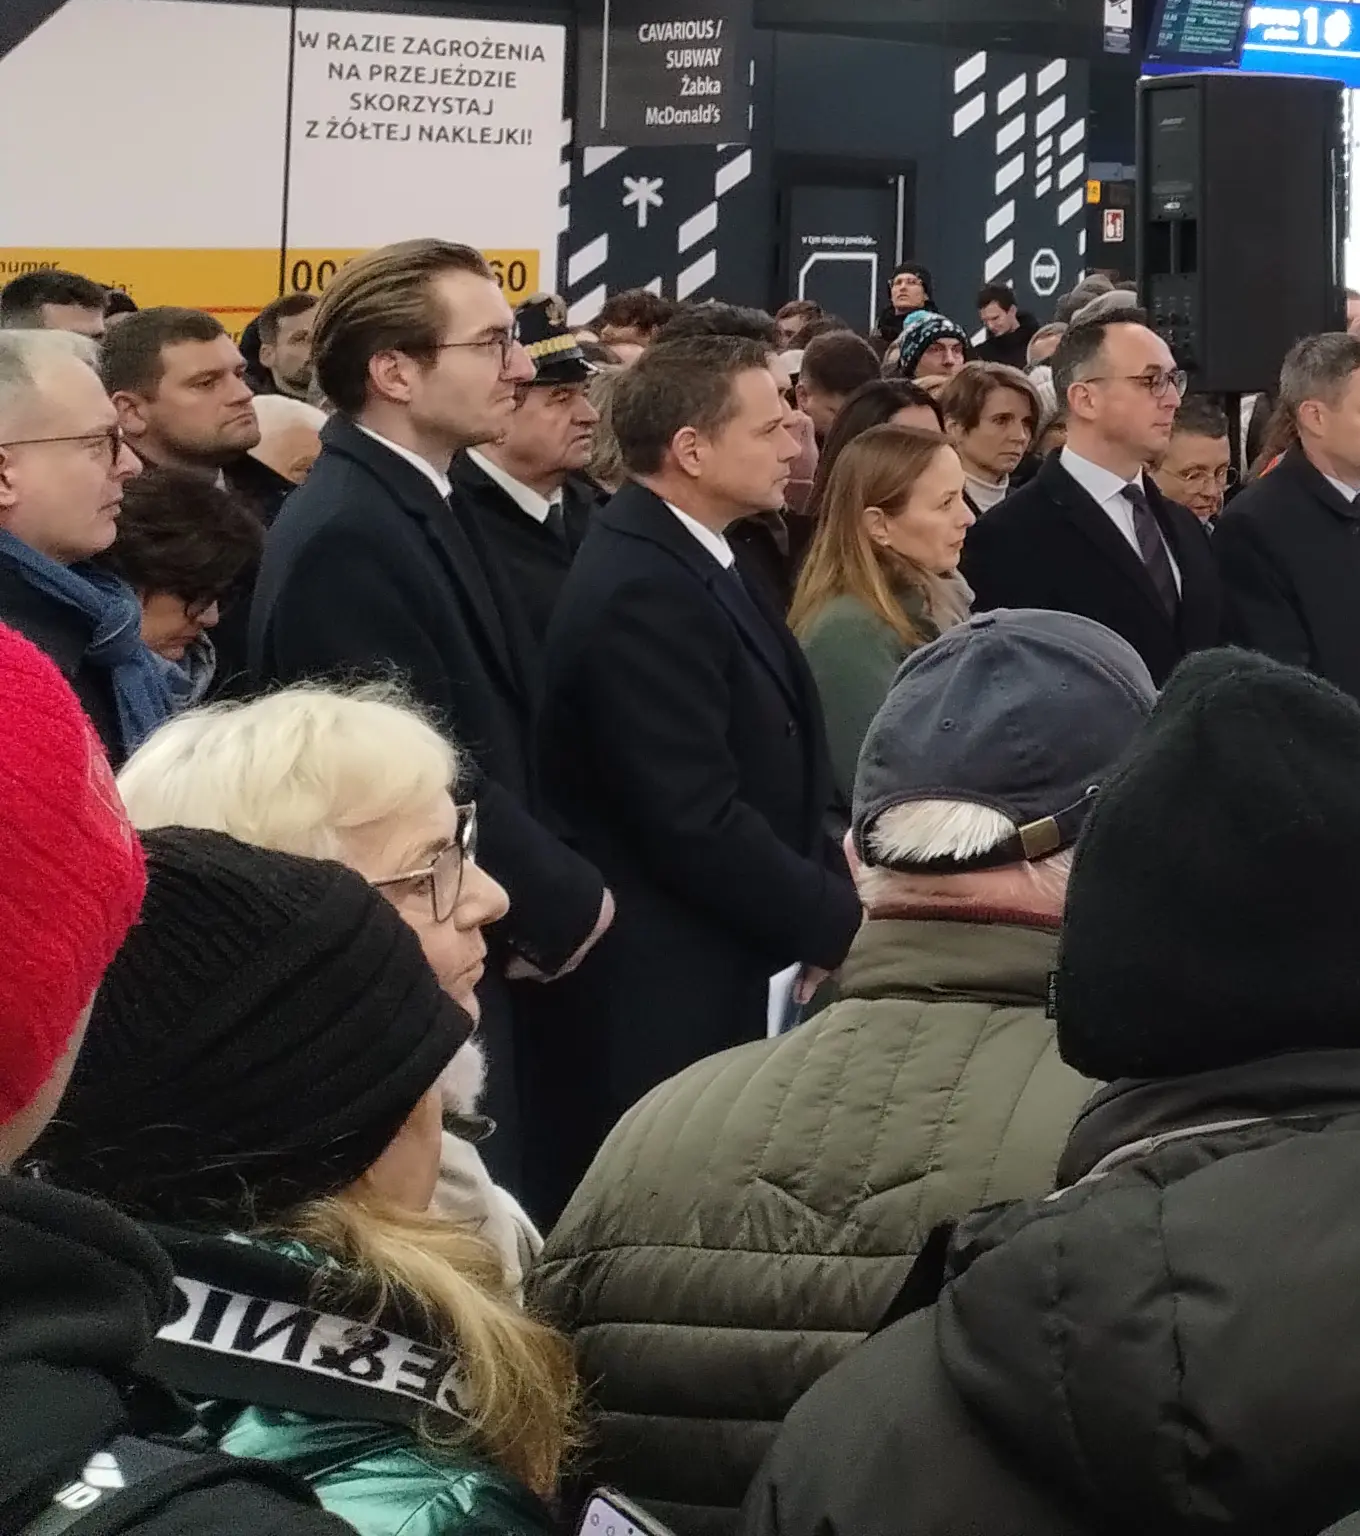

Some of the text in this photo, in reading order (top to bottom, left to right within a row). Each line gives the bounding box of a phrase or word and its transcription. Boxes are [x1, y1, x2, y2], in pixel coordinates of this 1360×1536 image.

[638, 19, 723, 42] CAVARIOUS /
[297, 30, 546, 62] W RAZIE ZAGROŻENIA
[665, 47, 722, 69] SUBWAY
[328, 62, 517, 89] NA PRZEJEŹDZIE
[680, 74, 721, 96] Żabka
[349, 92, 494, 116] SKORZYSTAJ
[645, 103, 721, 125] McDonald's
[305, 116, 533, 146] Z ŻÓŁTEJ NAKLEJKI!
